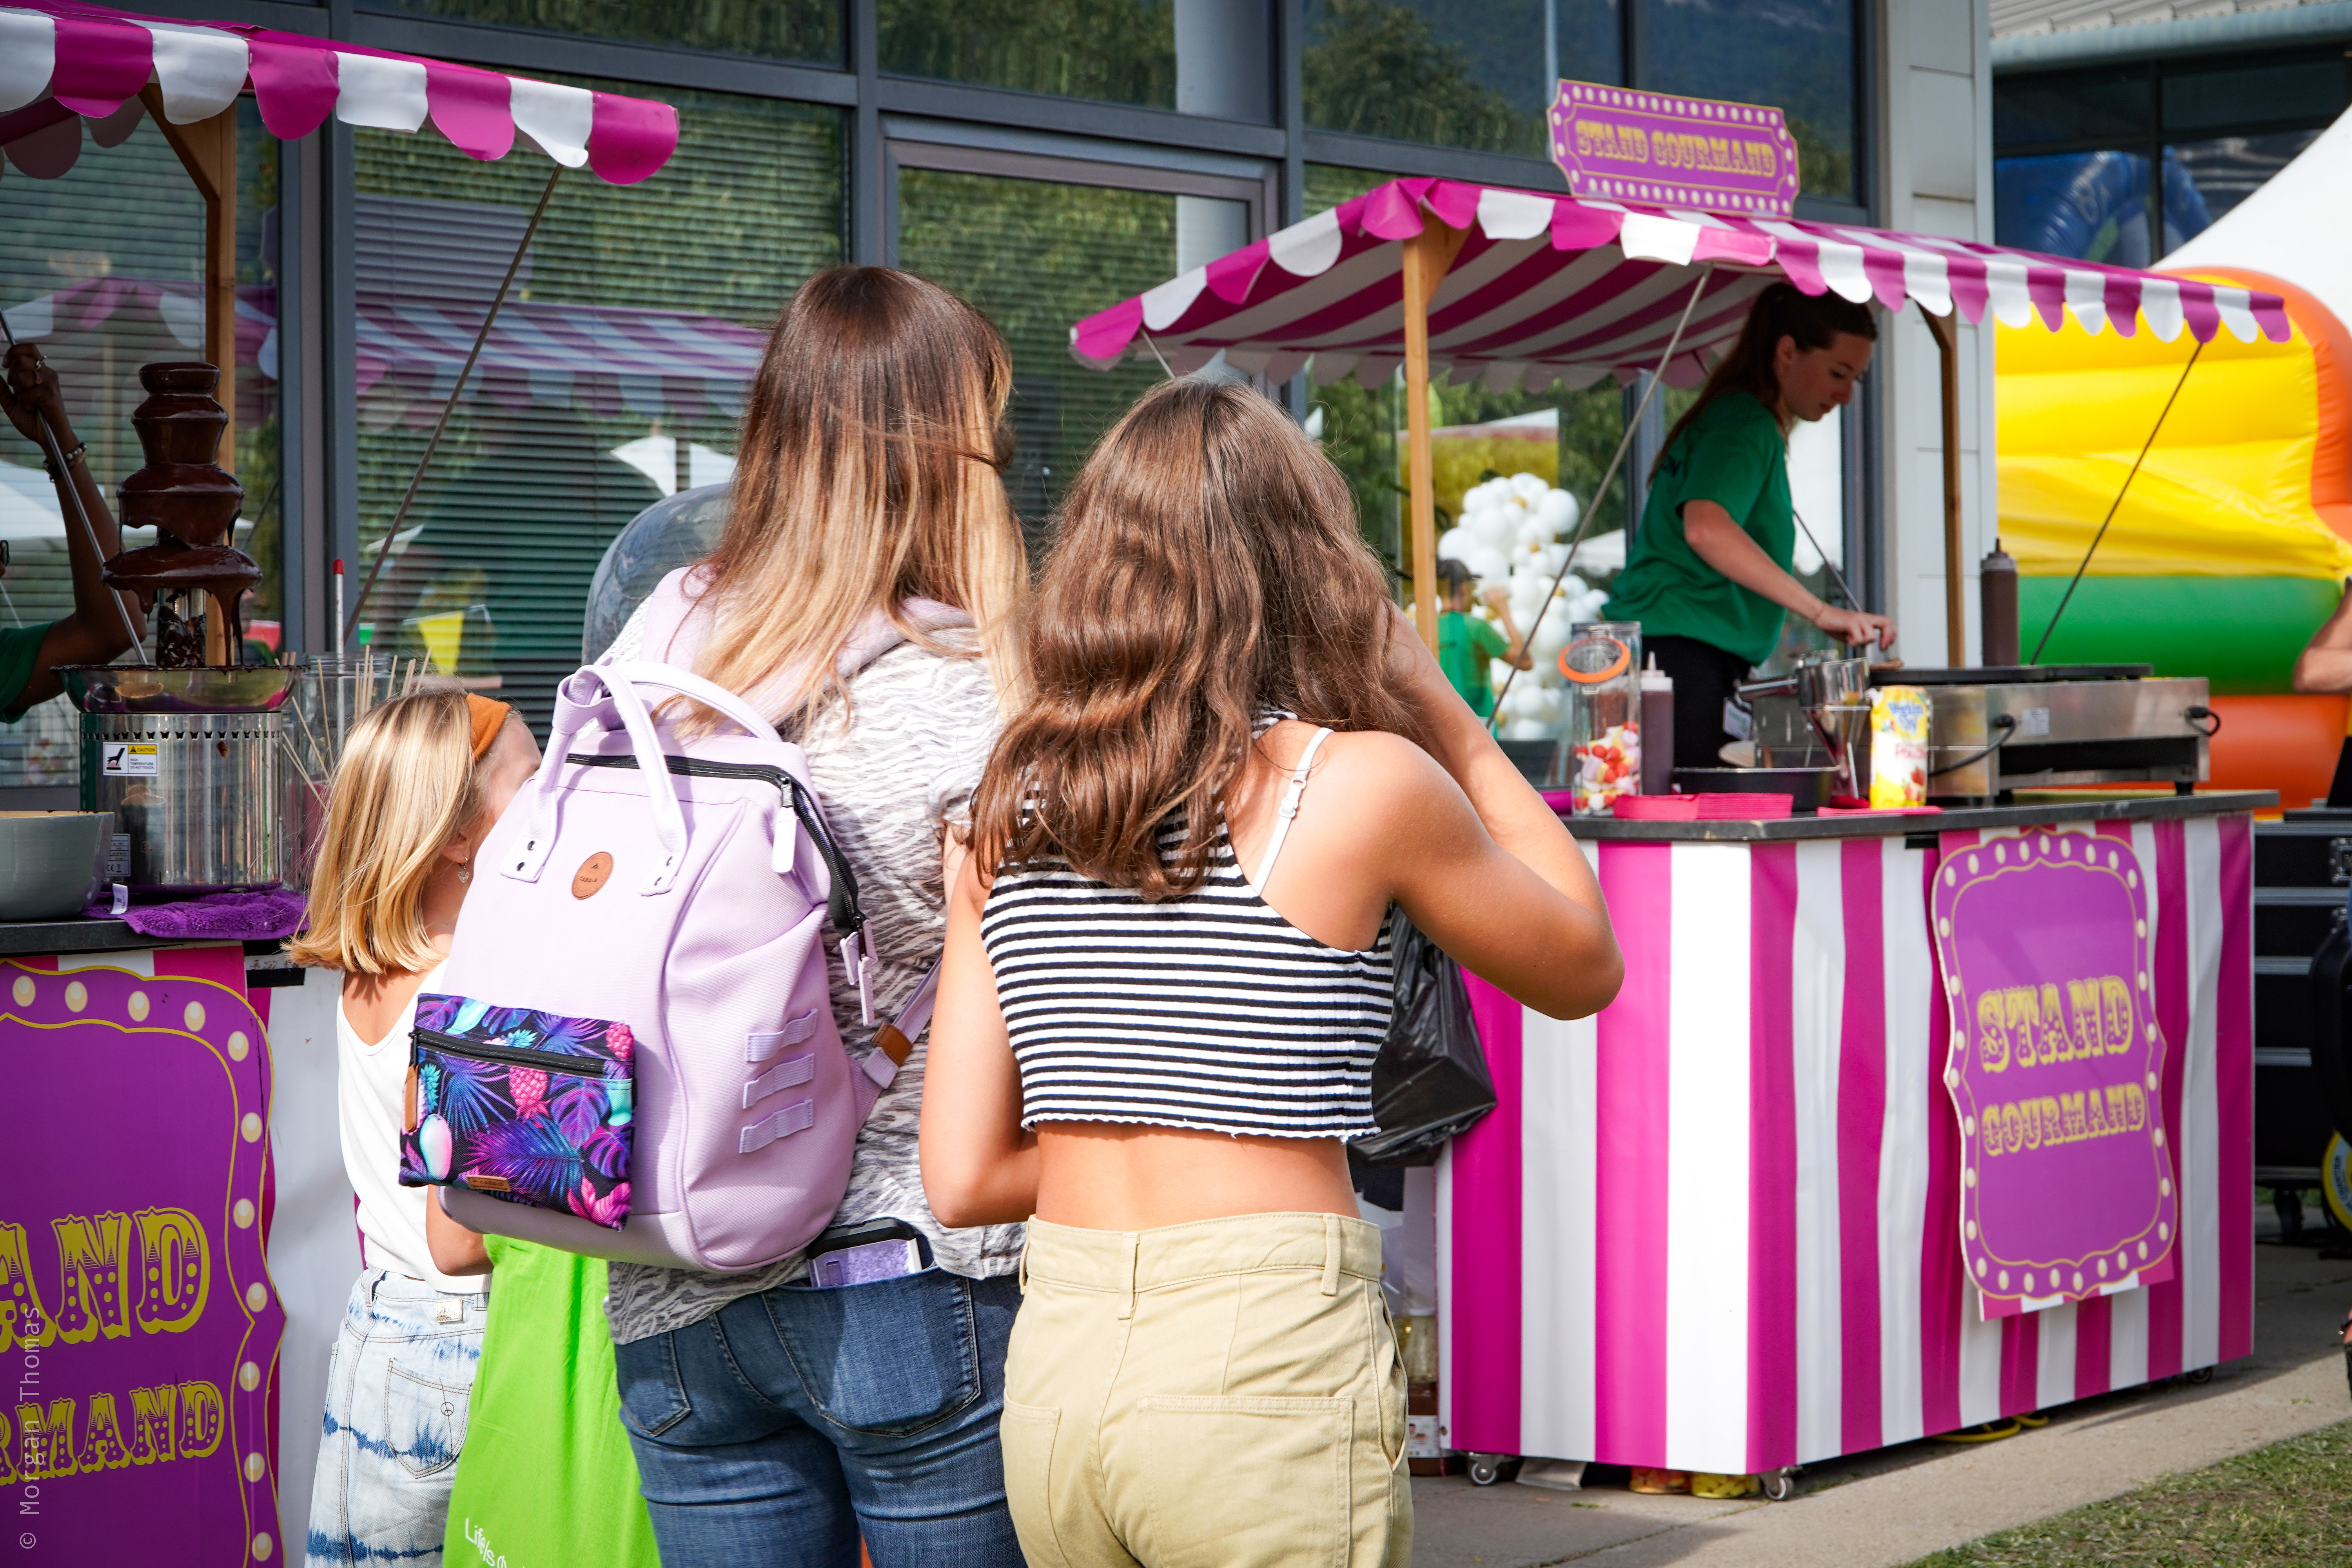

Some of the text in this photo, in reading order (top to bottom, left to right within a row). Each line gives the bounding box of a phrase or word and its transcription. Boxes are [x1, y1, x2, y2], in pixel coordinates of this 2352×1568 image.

[1575, 120, 1777, 178] STAND GOURMAND
[1977, 975, 2133, 1073] STAND
[1982, 1082, 2145, 1156] GOURMAND
[465, 1517, 486, 1554] Life
